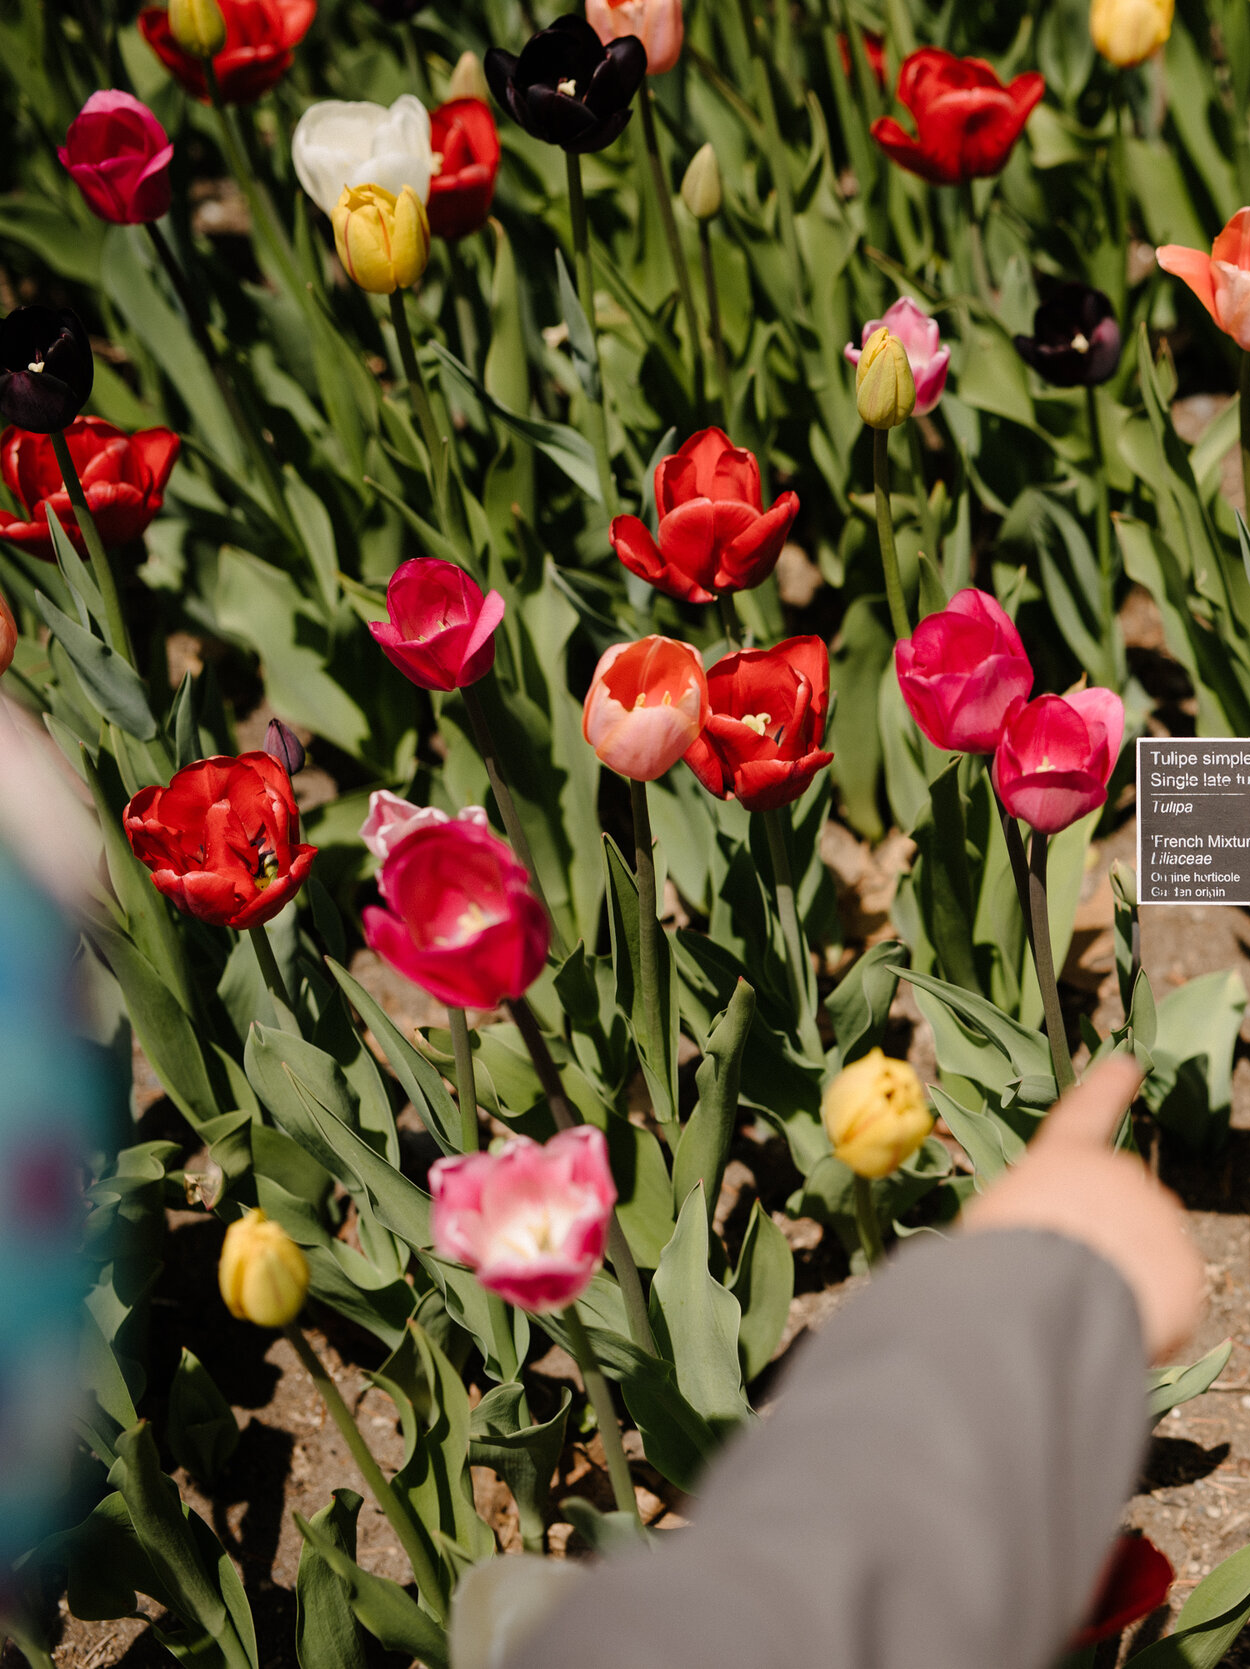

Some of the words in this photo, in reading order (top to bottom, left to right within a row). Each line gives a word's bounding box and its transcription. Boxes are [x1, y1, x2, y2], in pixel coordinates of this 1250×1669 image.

[1150, 751, 1198, 768] Tulipe
[1151, 772, 1199, 789] Single
[1203, 773, 1232, 787] late
[1152, 801, 1193, 815] Tulipa
[1151, 835, 1203, 848] 'French
[1151, 852, 1212, 865] Liliaceae
[1194, 872, 1240, 883] horticole
[1151, 887, 1192, 898] Gaden
